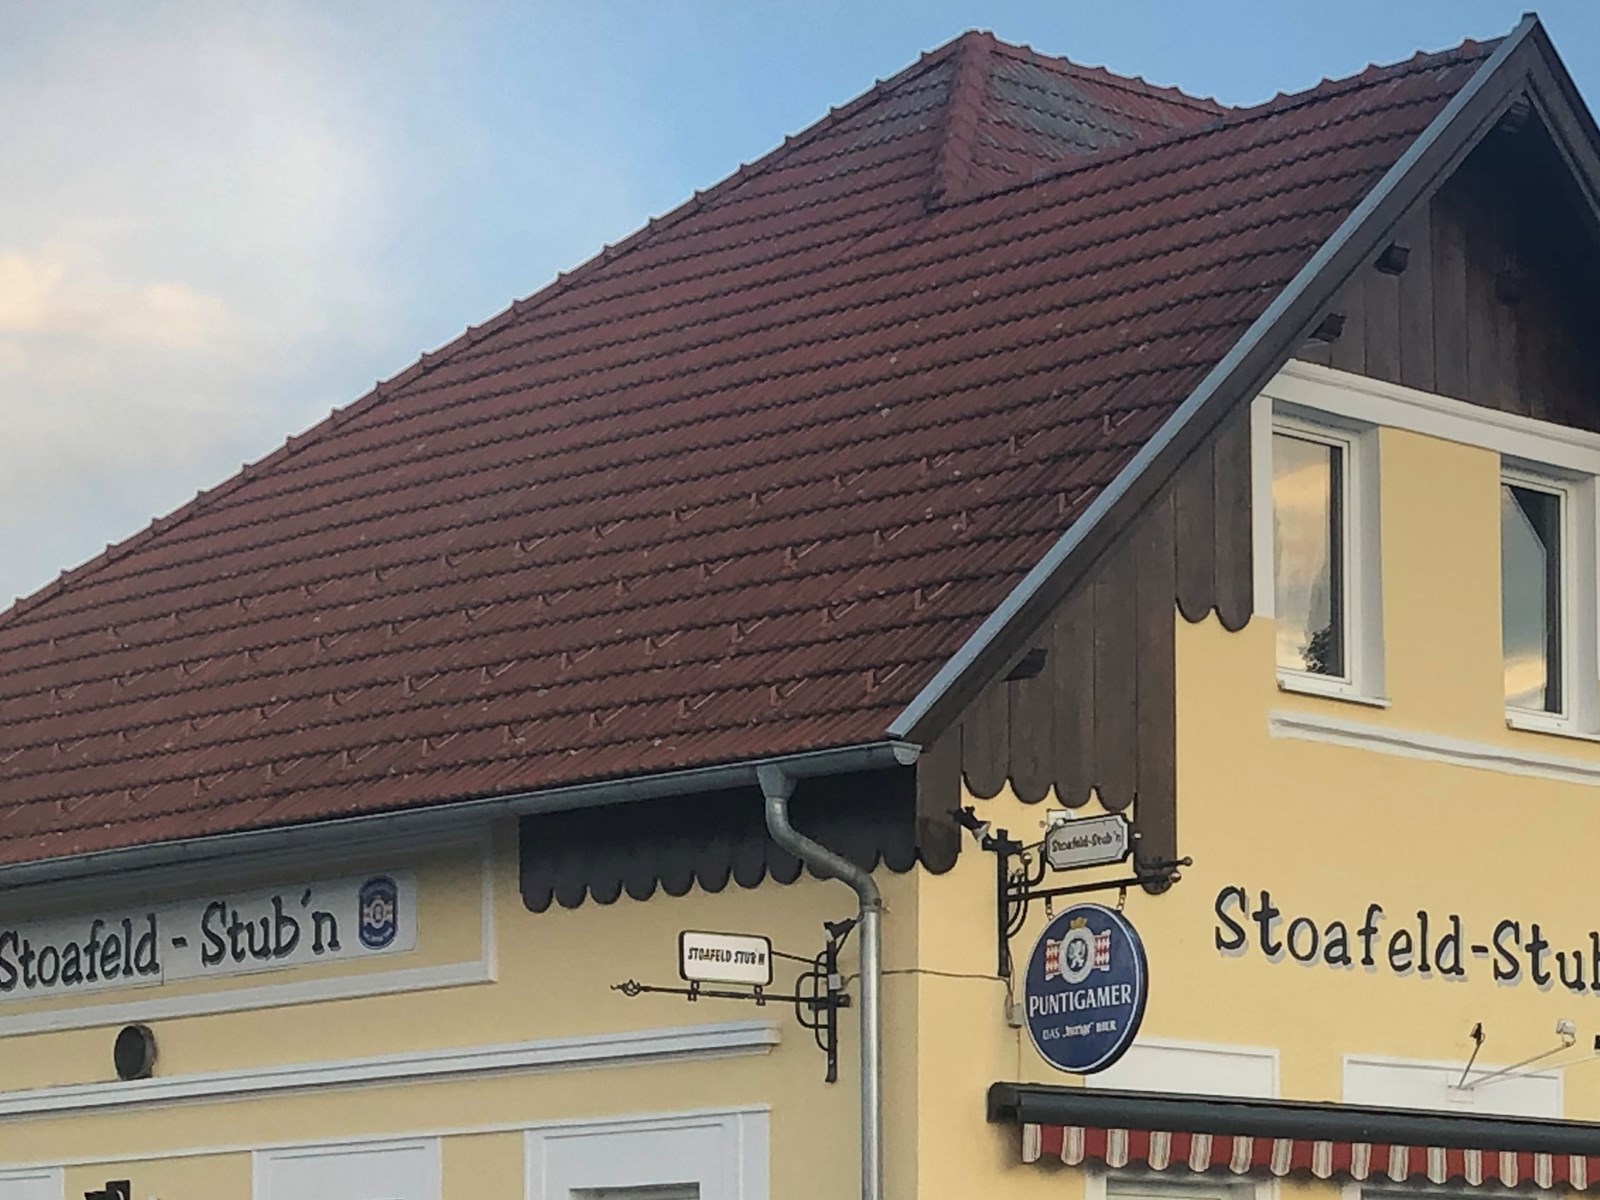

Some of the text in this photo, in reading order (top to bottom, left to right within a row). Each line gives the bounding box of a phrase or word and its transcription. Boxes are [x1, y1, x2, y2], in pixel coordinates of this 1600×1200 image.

[0, 912, 160, 992] Stoafeld
[687, 947, 733, 964] STOAFELD
[1029, 983, 1132, 1018] PUNTIGAMER
